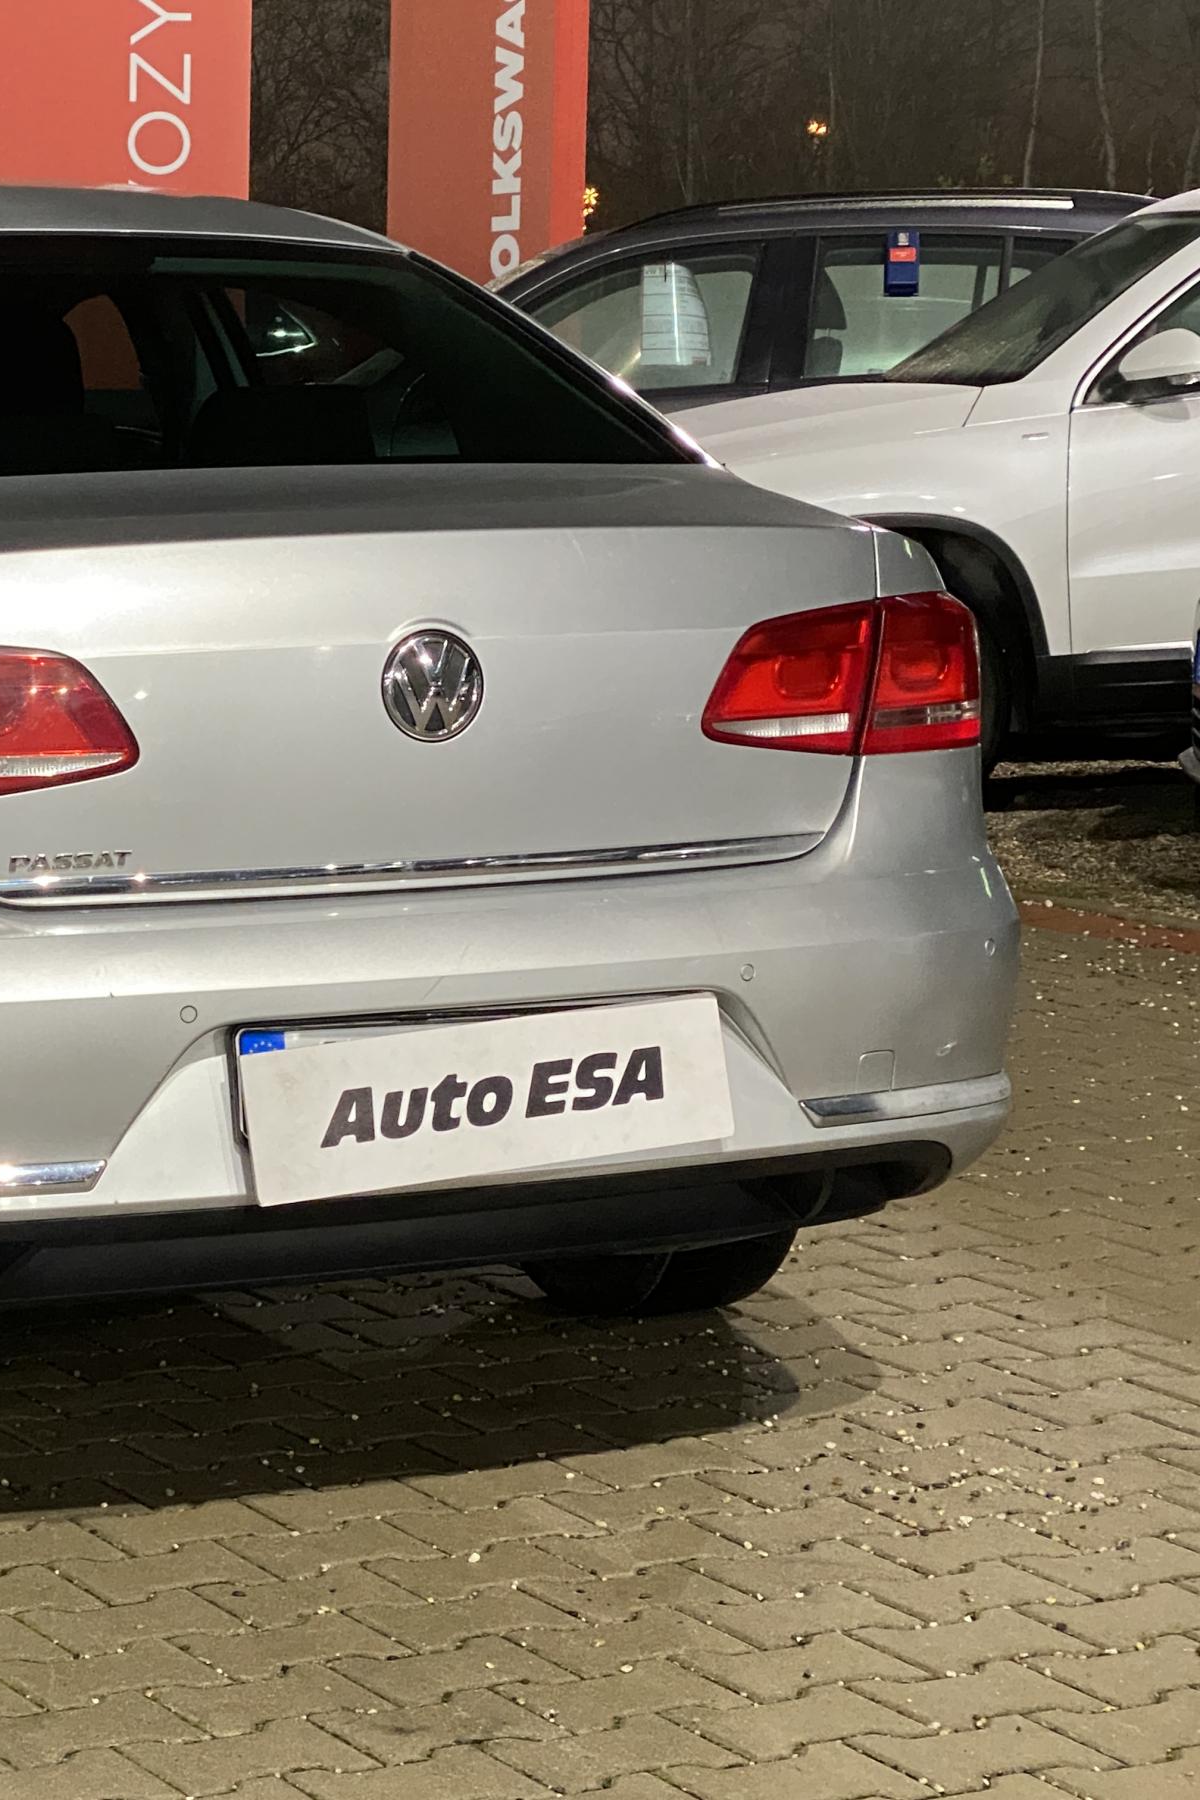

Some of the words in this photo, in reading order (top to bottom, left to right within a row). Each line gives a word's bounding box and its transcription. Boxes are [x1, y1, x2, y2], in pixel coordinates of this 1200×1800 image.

[127, 0, 192, 186] OZY
[490, 0, 526, 280] OLKSWA
[8, 849, 133, 873] PASSAT
[320, 1073, 513, 1148] Auto
[525, 1046, 665, 1118] ESA
